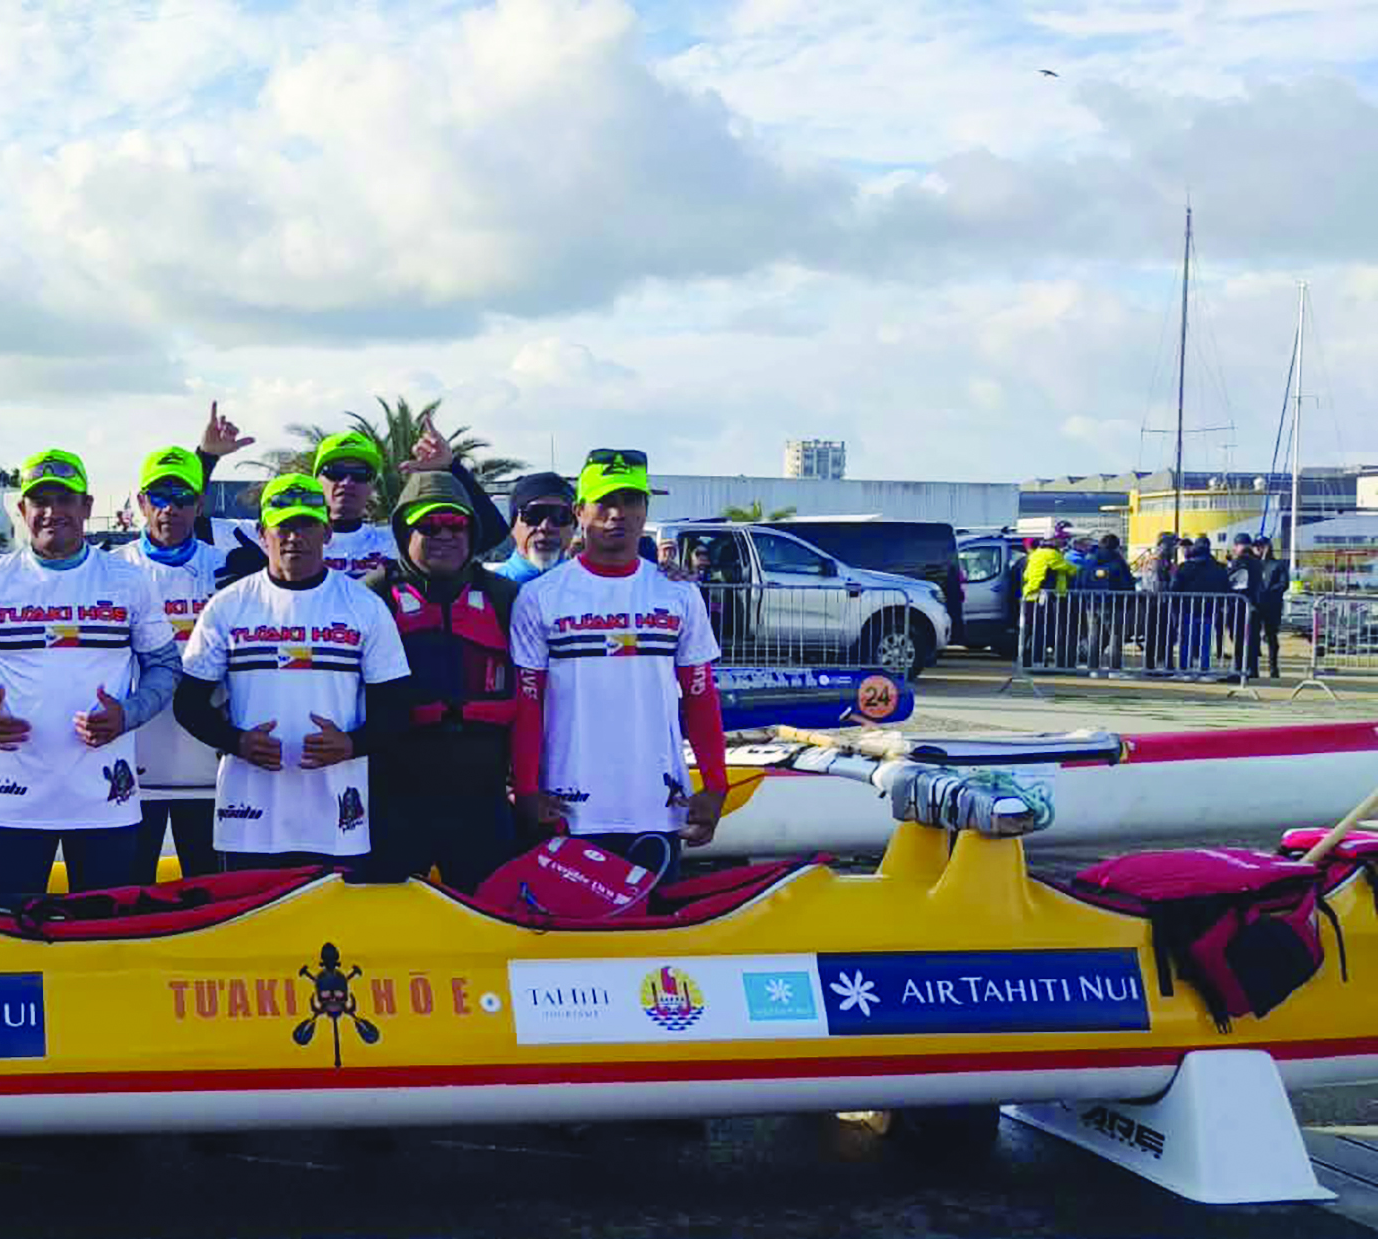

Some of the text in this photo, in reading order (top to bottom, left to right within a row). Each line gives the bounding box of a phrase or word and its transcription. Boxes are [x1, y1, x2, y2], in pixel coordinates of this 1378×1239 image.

[864, 686, 890, 708] 24
[901, 974, 1140, 1005] AIR TAHITI NUI
